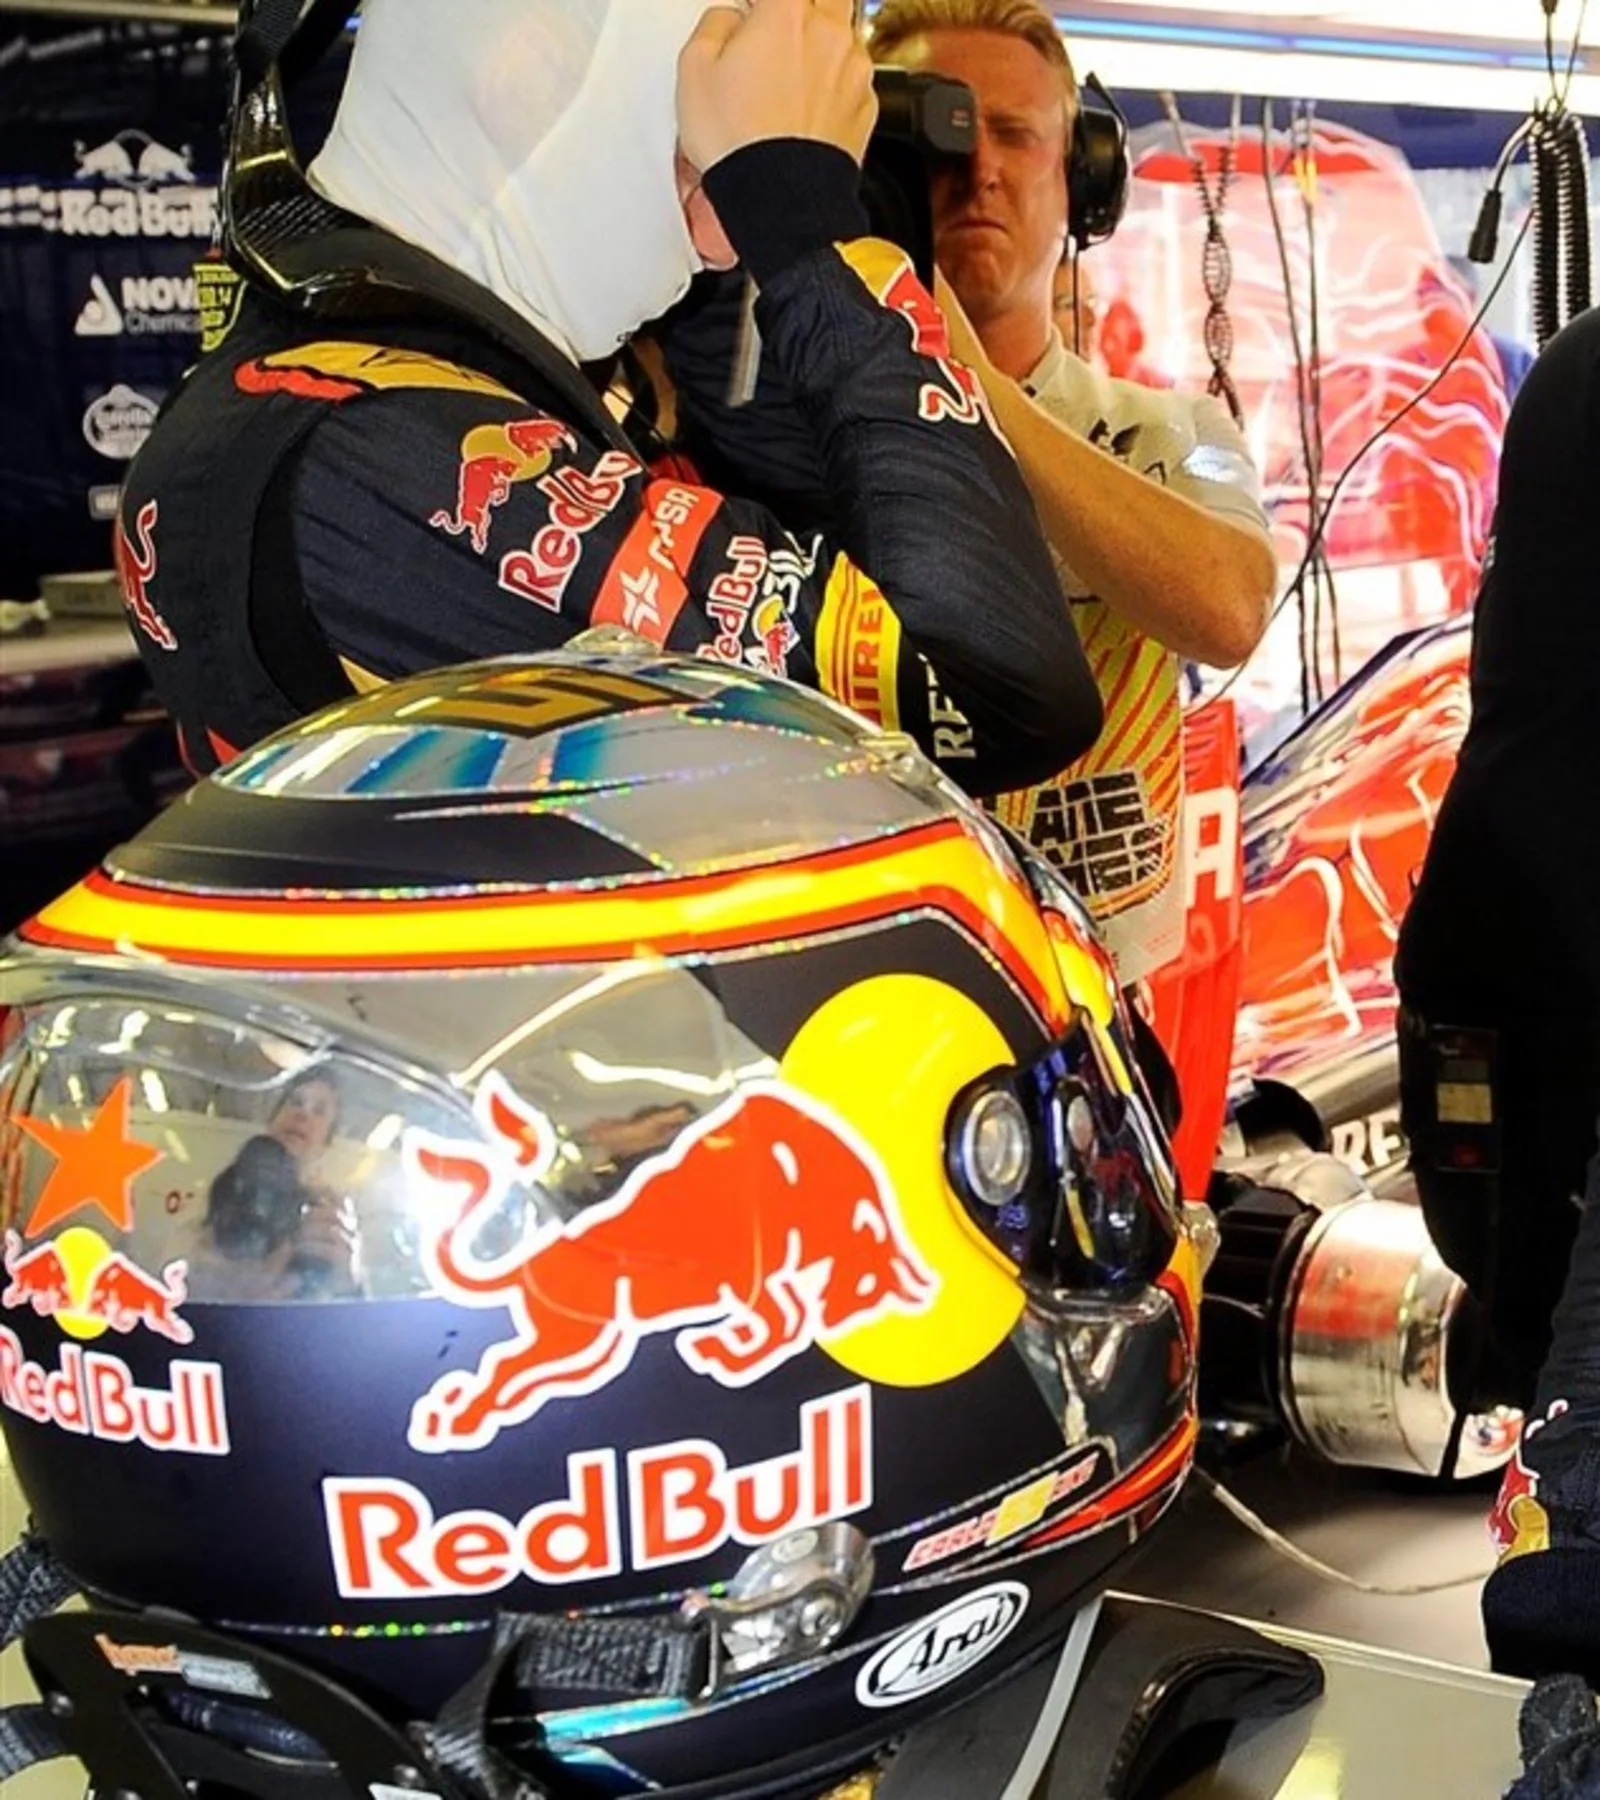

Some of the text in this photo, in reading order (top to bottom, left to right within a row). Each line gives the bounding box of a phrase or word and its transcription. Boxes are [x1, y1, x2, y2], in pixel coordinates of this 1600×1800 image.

[121, 277, 200, 310] NOV
[84, 1350, 231, 1456] Bull
[323, 1383, 873, 1599] Red Bull
[895, 1597, 1007, 1676] Arai
